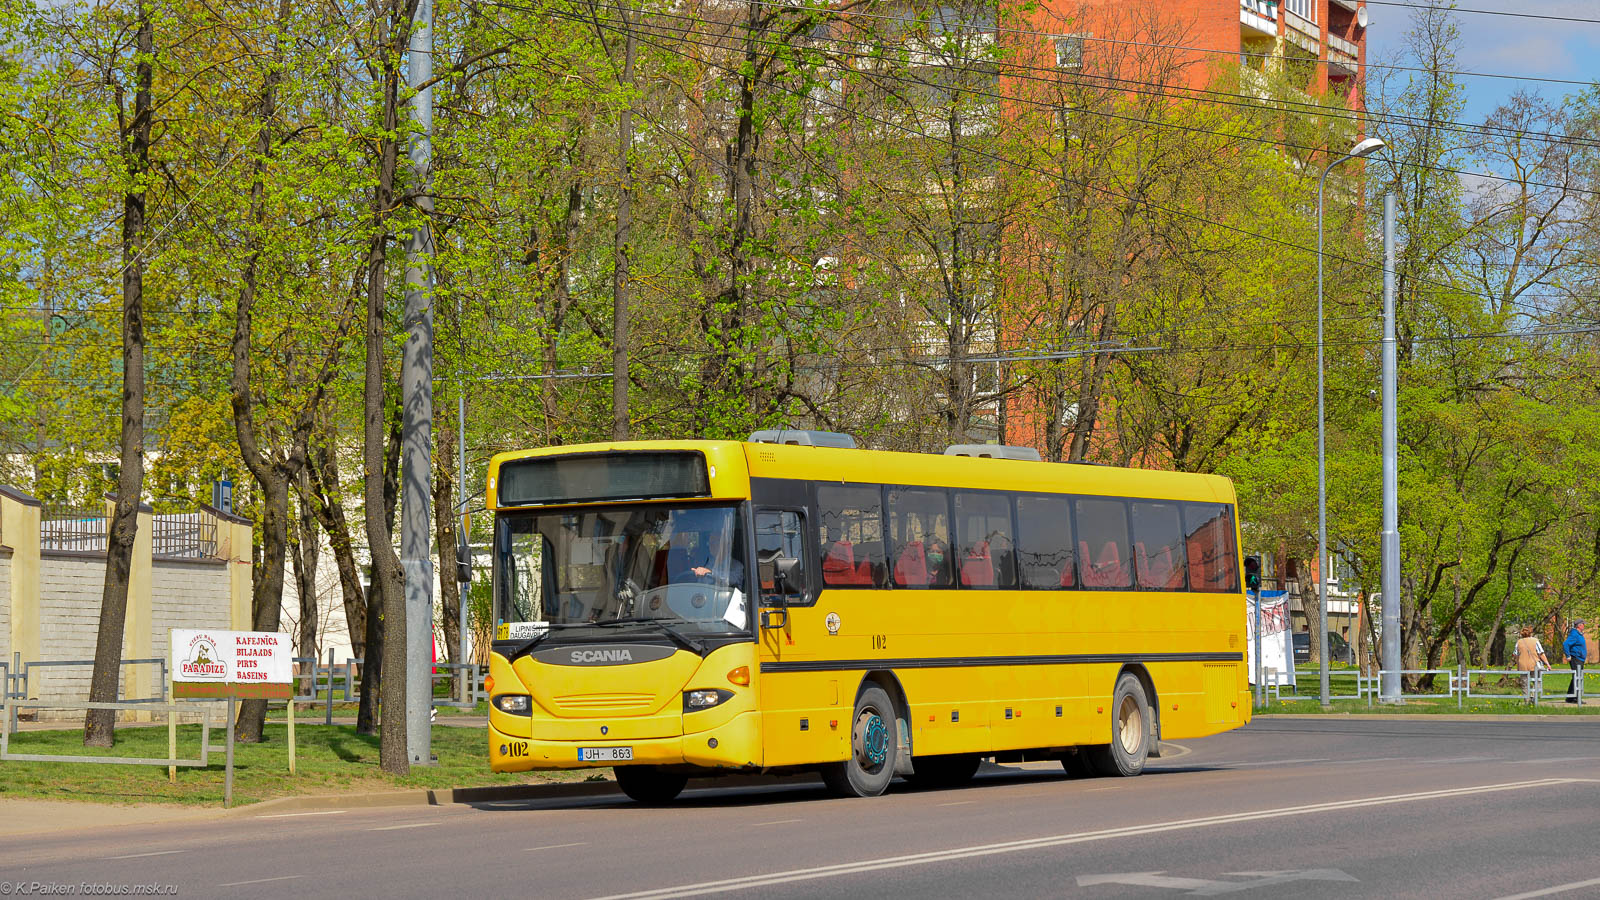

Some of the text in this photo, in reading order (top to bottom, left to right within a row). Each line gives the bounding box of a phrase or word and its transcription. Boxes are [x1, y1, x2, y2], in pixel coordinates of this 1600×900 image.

[236, 635, 278, 646] KAFEJNĪCA
[872, 634, 887, 650] 102
[570, 649, 633, 663] SCANIA
[183, 662, 225, 674] PARADĪZE
[236, 659, 258, 668] PIRTS
[236, 671, 268, 680] BASEINS
[508, 741, 529, 757] 102
[612, 748, 631, 759] 863
